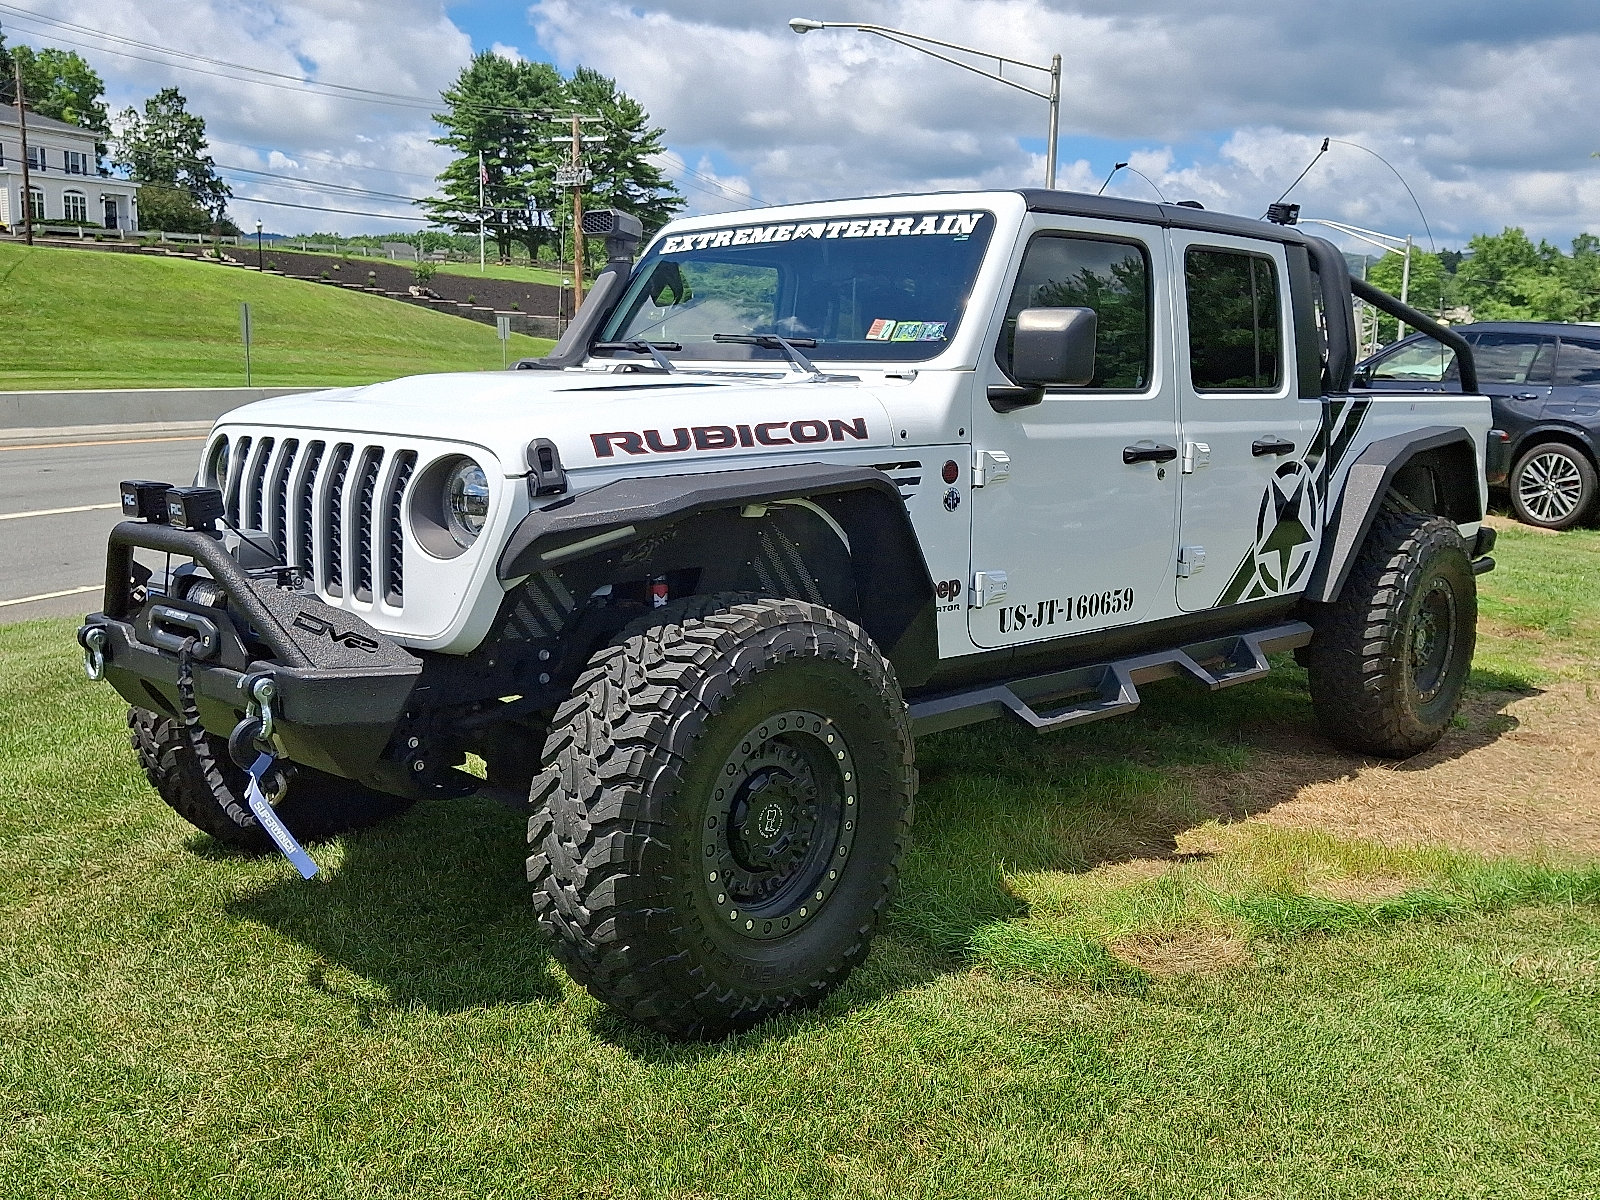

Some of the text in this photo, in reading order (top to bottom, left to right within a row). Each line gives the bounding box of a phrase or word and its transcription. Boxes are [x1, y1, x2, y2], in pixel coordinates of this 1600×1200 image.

[659, 213, 985, 255] EXTREME TERRAIN
[589, 417, 869, 458] RUBICON
[124, 494, 136, 506] RC
[169, 503, 183, 515] RC
[936, 579, 962, 602] ep
[998, 588, 1134, 634] US-JT-160659
[253, 801, 297, 854] SUPERWINCH
